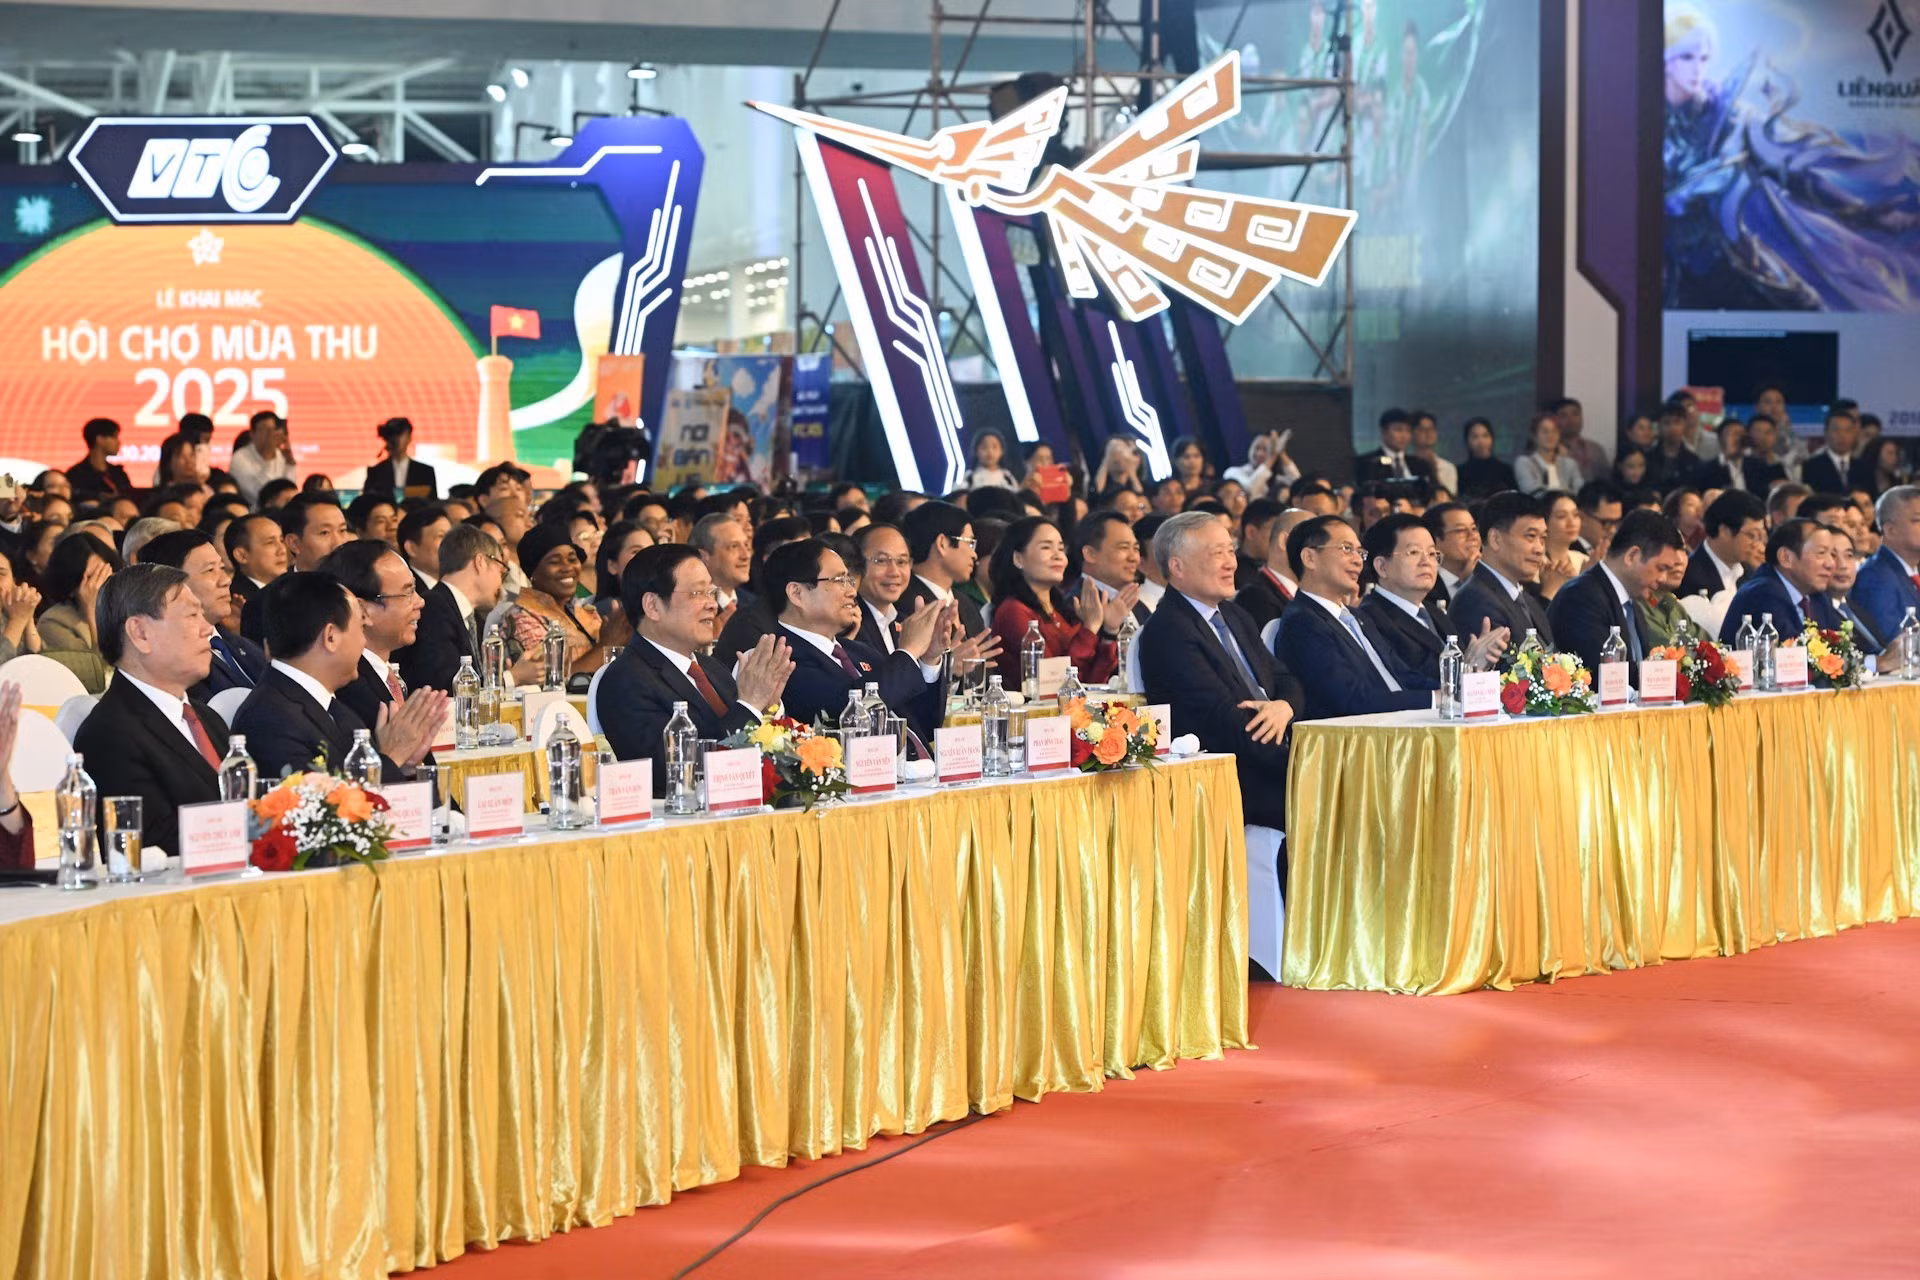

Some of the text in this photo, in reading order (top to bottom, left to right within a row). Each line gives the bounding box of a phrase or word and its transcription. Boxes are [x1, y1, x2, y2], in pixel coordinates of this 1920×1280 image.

[127, 124, 281, 213] VTC
[180, 289, 220, 309] KHAI
[42, 319, 379, 365] HỘI CHỢ MÙA THU
[134, 367, 289, 427] 2025
